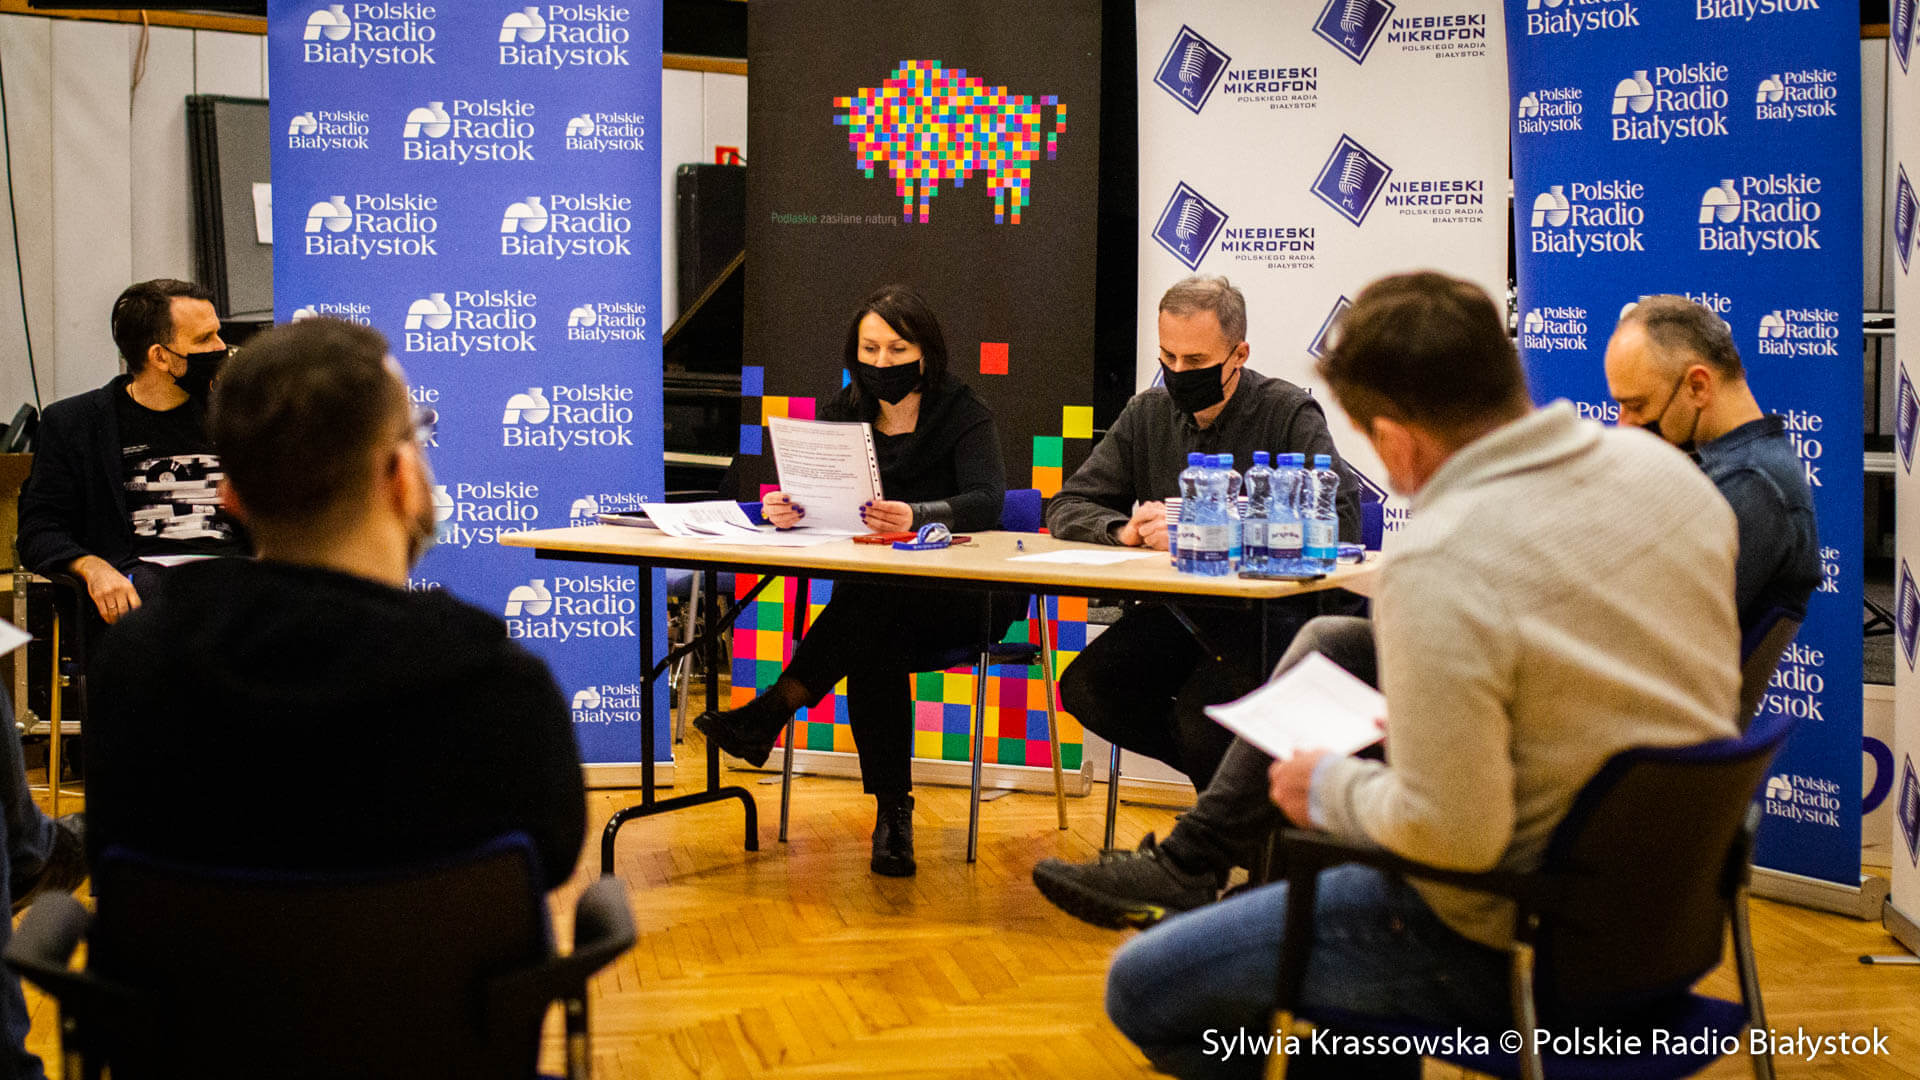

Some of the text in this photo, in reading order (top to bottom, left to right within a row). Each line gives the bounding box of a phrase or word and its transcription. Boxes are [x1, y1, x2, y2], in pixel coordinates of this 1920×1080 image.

[354, 2, 436, 20] Polskie
[549, 4, 629, 22] Polskie
[1527, 3, 1640, 37] Białystok
[1392, 14, 1485, 29] NIEBIESKI
[354, 21, 436, 42] Radio
[549, 23, 629, 43] Radio
[1388, 27, 1485, 43] MIKROFON
[304, 42, 436, 69] Białystok
[1401, 41, 1487, 52] POLSKIEGO RADIA
[1434, 50, 1486, 59] BIAŁYSTOK
[500, 44, 629, 70] Białystok
[1228, 67, 1317, 81] NIEBIESKI
[1656, 62, 1728, 86] Polskie
[1784, 69, 1837, 85] Polskie
[1224, 80, 1317, 94] MIKROFON
[1540, 87, 1582, 101] Polskie
[1785, 83, 1837, 101] Radio
[1237, 95, 1289, 103] POLSKIEGO
[1269, 101, 1317, 110] BIAŁYSTOK
[1656, 84, 1728, 112] Radio
[319, 111, 369, 122] Polskie
[453, 99, 534, 116] Polskie
[1540, 100, 1582, 117] Radio
[1756, 100, 1837, 122] Białystok
[596, 112, 644, 124] Polskie
[1519, 115, 1583, 135] Białystok
[1612, 110, 1728, 144] Białystok
[319, 122, 369, 135] Radio
[453, 118, 534, 138] Radio
[596, 123, 644, 137] Radio
[289, 135, 369, 151] Białystok
[566, 137, 644, 153] Białystok
[404, 140, 534, 165] Białystok
[1390, 180, 1483, 193] NIEBIESKI
[1572, 180, 1644, 201] Polskie
[1743, 173, 1821, 196] Polskie
[356, 193, 437, 211] Polskie
[551, 193, 631, 211] Polskie
[1385, 194, 1483, 206] MIKROFON
[1571, 201, 1644, 226] Radio
[1743, 196, 1821, 223] Radio
[355, 212, 437, 233] Radio
[551, 212, 631, 233] Radio
[771, 212, 897, 227] Podlaskie zasilane naturą
[1431, 216, 1483, 224] BIAŁYSTOK
[1226, 228, 1314, 239] NIEBIESKI
[1532, 227, 1644, 258] Białystok
[1699, 224, 1821, 256] Białystok
[306, 234, 437, 260] Białystok
[501, 234, 631, 260] Białystok
[1221, 241, 1314, 252] MIKROFON
[1267, 262, 1315, 270] BIAŁYSTOK
[455, 290, 536, 307] Polskie
[598, 302, 646, 313] Polskie
[320, 303, 370, 314] Polskie
[1544, 307, 1587, 319] Polskie
[1786, 309, 1839, 322] Polskie
[455, 308, 536, 329] Radio
[598, 313, 646, 327] Radio
[1543, 319, 1587, 334] Radio
[568, 327, 645, 343] Białystok
[1785, 322, 1839, 339] Radio
[405, 330, 536, 357] Białystok
[1523, 334, 1587, 352] Białystok
[1759, 339, 1838, 358] Białystok
[553, 384, 633, 401] Polskie
[552, 403, 633, 424] Radio
[1576, 401, 1619, 421] Pols
[503, 425, 633, 451] Białystok
[457, 481, 538, 499] Polskie
[600, 493, 648, 504] Polskie
[456, 500, 538, 521] Radio
[555, 575, 635, 593] Polskie
[555, 594, 635, 615] Radio
[506, 616, 636, 643] Białystok
[1780, 643, 1824, 666] skie
[1768, 665, 1824, 693] adio
[602, 684, 640, 695] Polsk
[602, 695, 640, 709] Radi
[1754, 693, 1824, 721] ystok
[572, 709, 641, 725] Białysto
[1793, 775, 1840, 794] Polskie
[1793, 788, 1840, 810] Radio
[1766, 800, 1840, 827] Białystok
